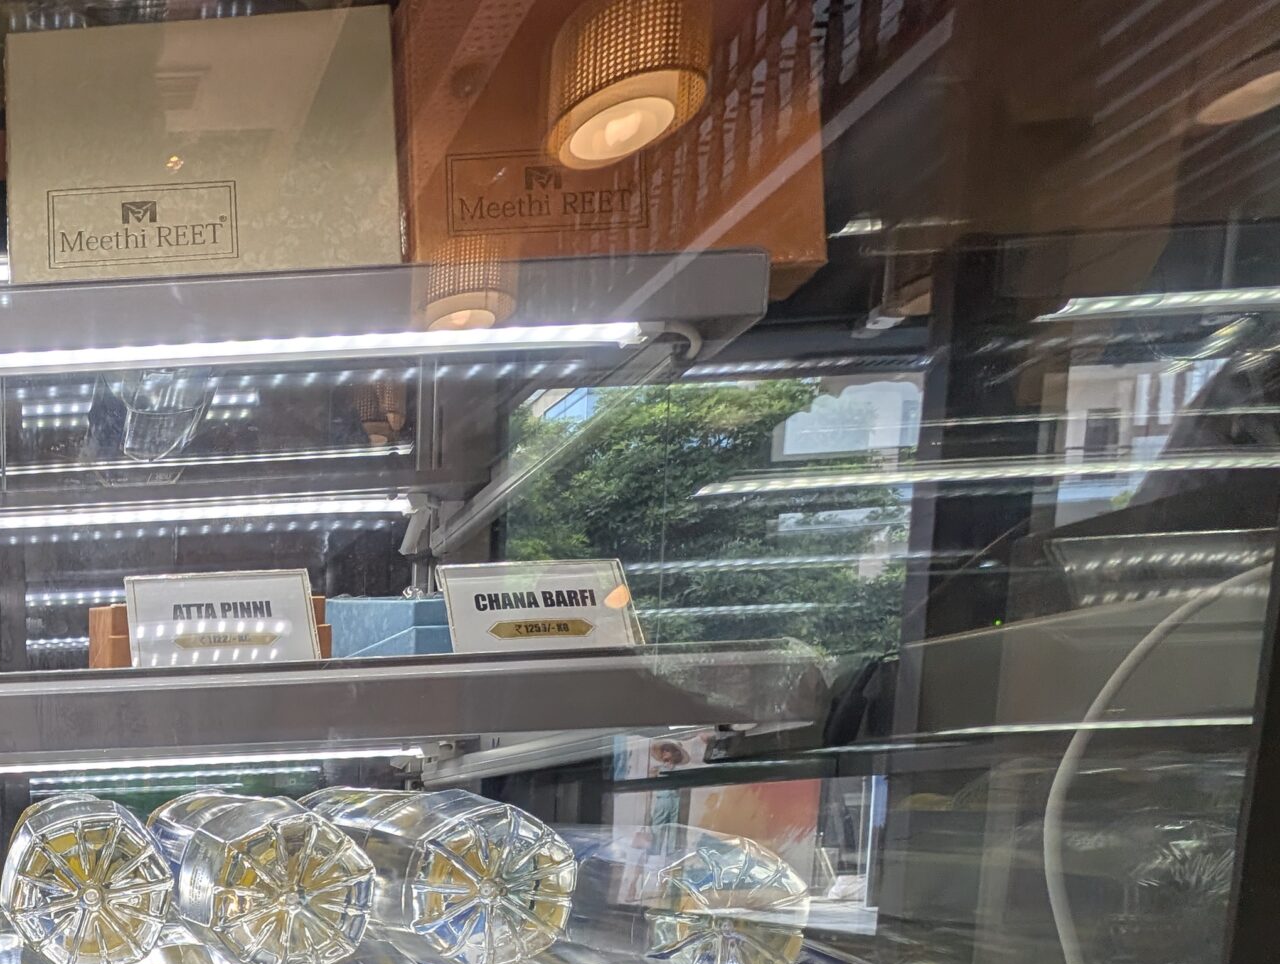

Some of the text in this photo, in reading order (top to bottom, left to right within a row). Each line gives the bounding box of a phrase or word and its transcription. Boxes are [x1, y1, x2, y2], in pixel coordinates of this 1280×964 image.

[459, 189, 633, 222] Meethi REET
[59, 221, 223, 253] Meethi REET
[173, 600, 272, 620] ATTA PINNI
[474, 589, 597, 612] CHANA BARFI
